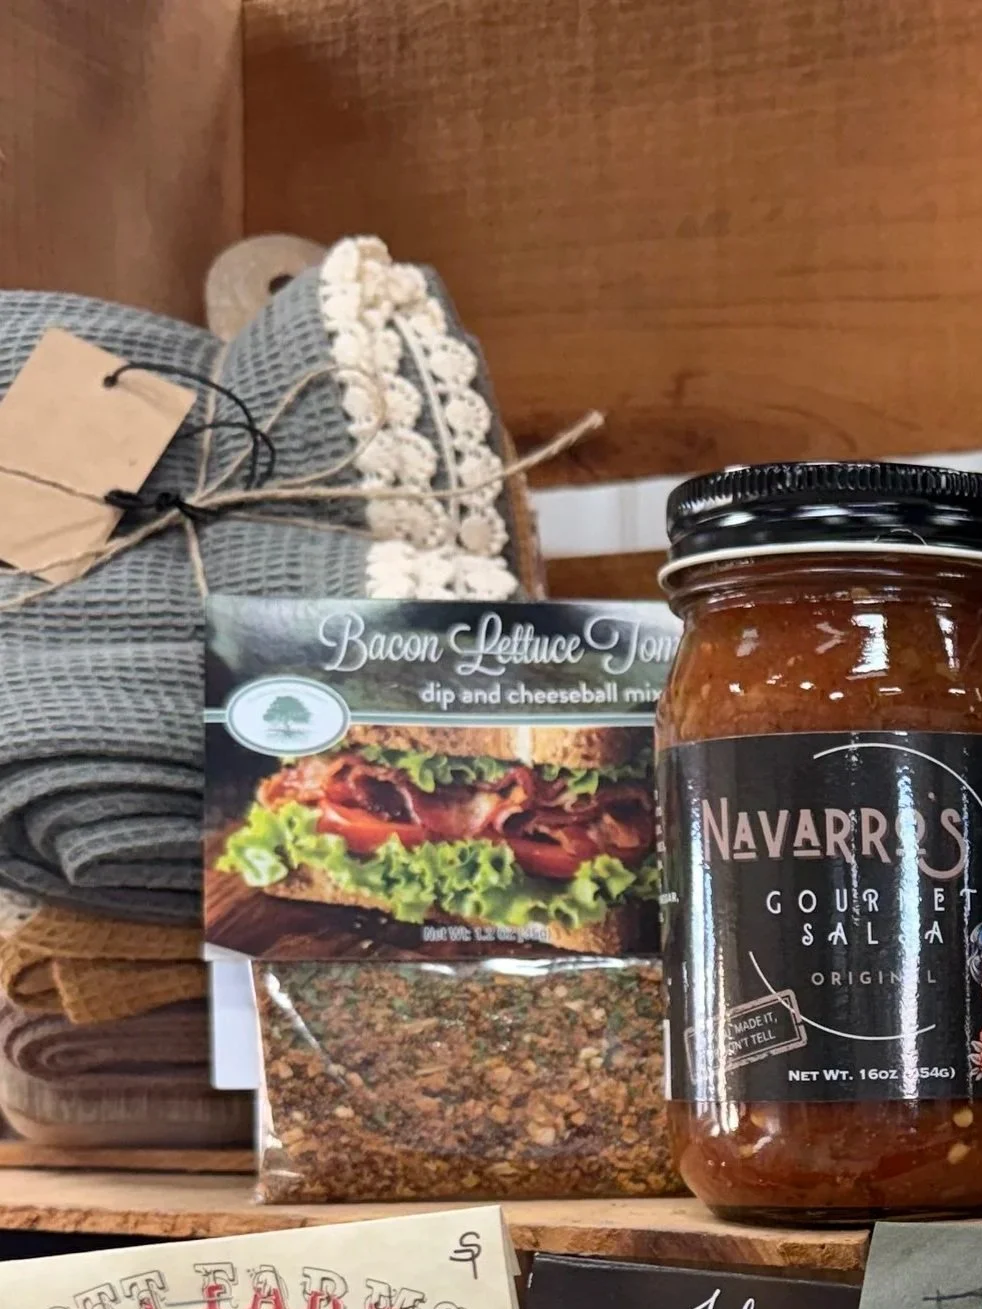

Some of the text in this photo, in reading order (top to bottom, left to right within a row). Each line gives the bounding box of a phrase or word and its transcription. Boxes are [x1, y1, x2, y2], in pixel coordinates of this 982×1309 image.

[318, 611, 443, 673] Bacon
[448, 611, 584, 676] Lettuce
[420, 682, 456, 710] dip
[461, 682, 500, 704] and
[507, 682, 617, 705] cheeseball
[766, 887, 977, 915] GOURET
[802, 919, 945, 947] SALA
[811, 969, 937, 986] ORIGINL
[734, 1015, 764, 1035] MADE
[750, 1029, 776, 1046] TELL
[788, 1069, 820, 1082] NET
[823, 1069, 854, 1082] WT.
